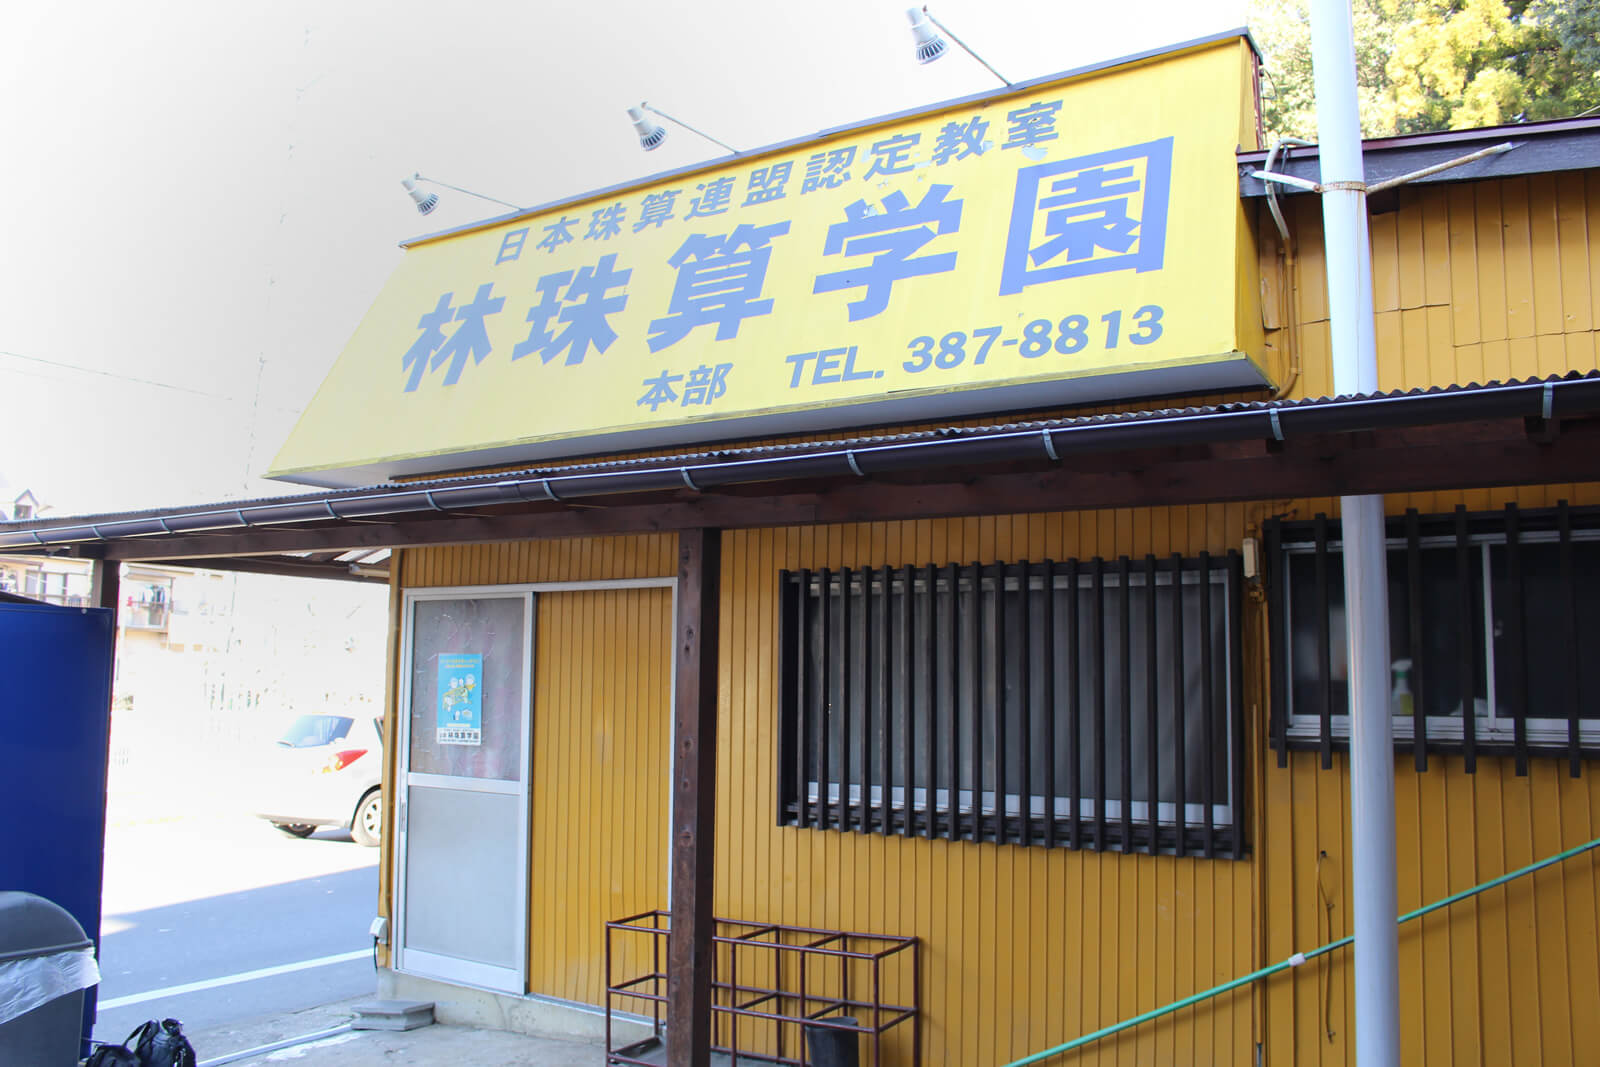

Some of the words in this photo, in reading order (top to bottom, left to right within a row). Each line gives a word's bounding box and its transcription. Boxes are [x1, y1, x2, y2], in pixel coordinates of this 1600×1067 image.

[401, 136, 1174, 393] 林珠算学園
[495, 100, 1063, 266] 日本珠算連盟認定教室
[636, 362, 734, 412] 本部
[785, 346, 884, 388] TEL.
[902, 305, 1164, 373] 387-8813
